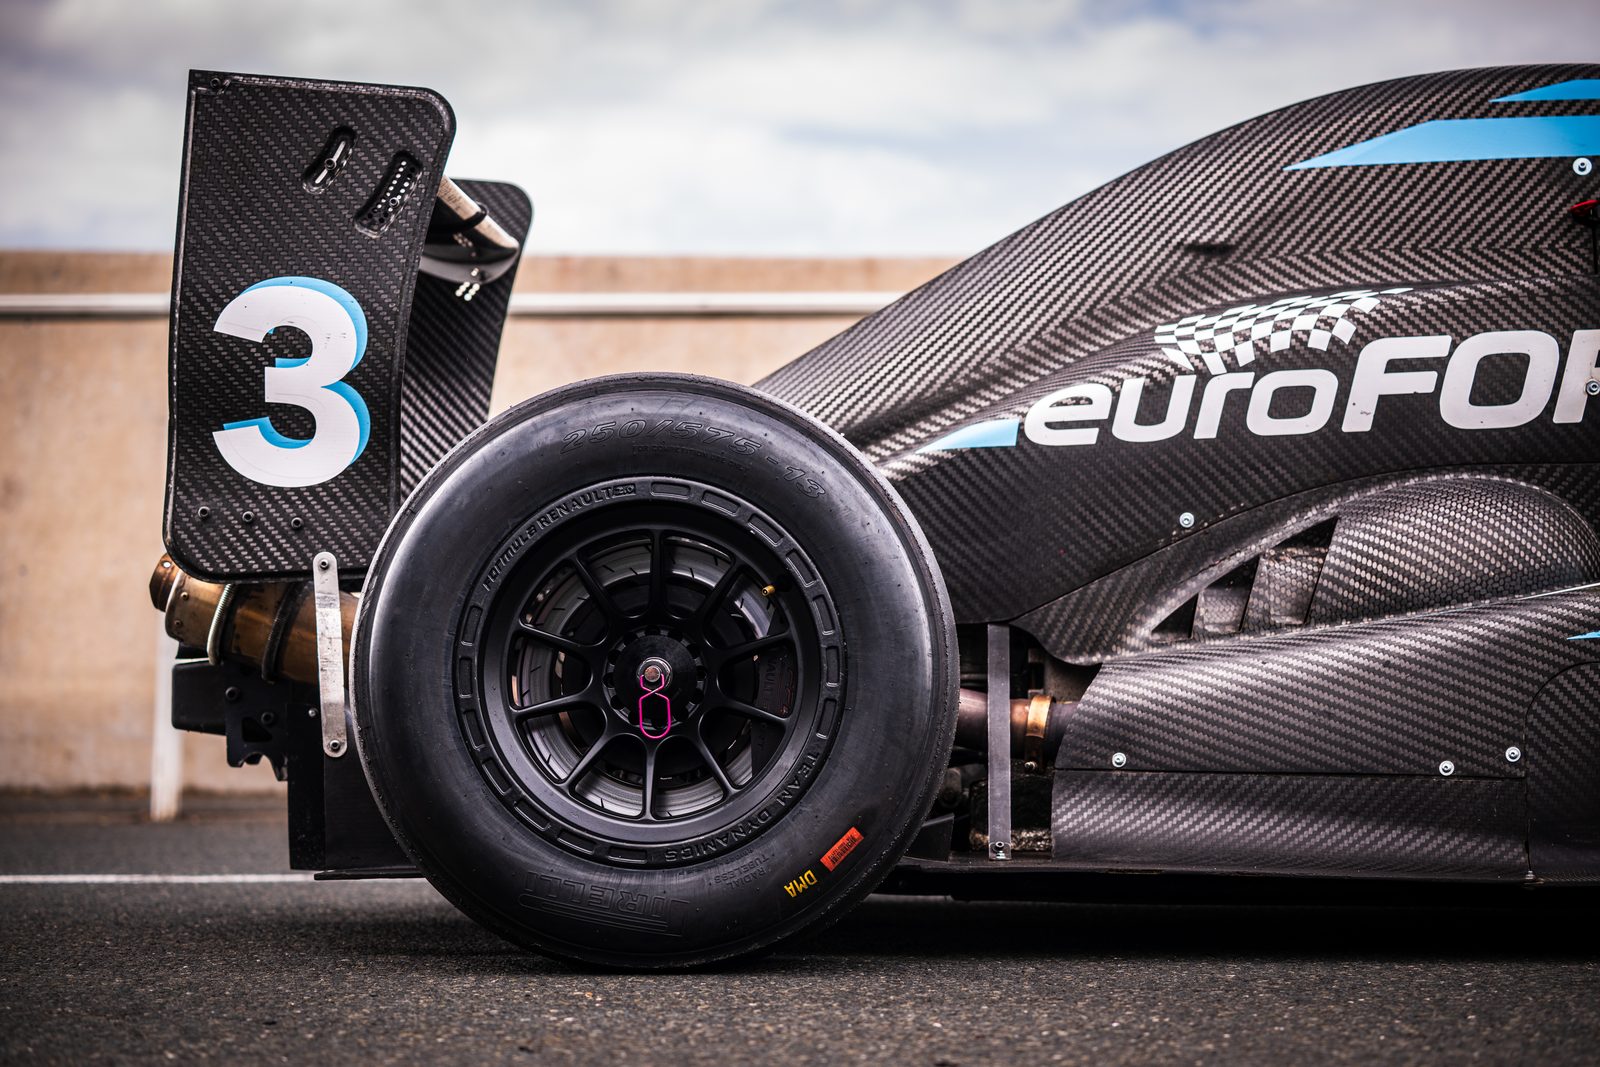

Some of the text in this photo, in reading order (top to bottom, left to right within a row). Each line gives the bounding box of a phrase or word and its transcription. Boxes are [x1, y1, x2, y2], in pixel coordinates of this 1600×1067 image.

[213, 276, 371, 488] 3
[776, 752, 820, 807] TEAM
[664, 808, 773, 861] DYNAMICS
[783, 869, 818, 898] DMA
